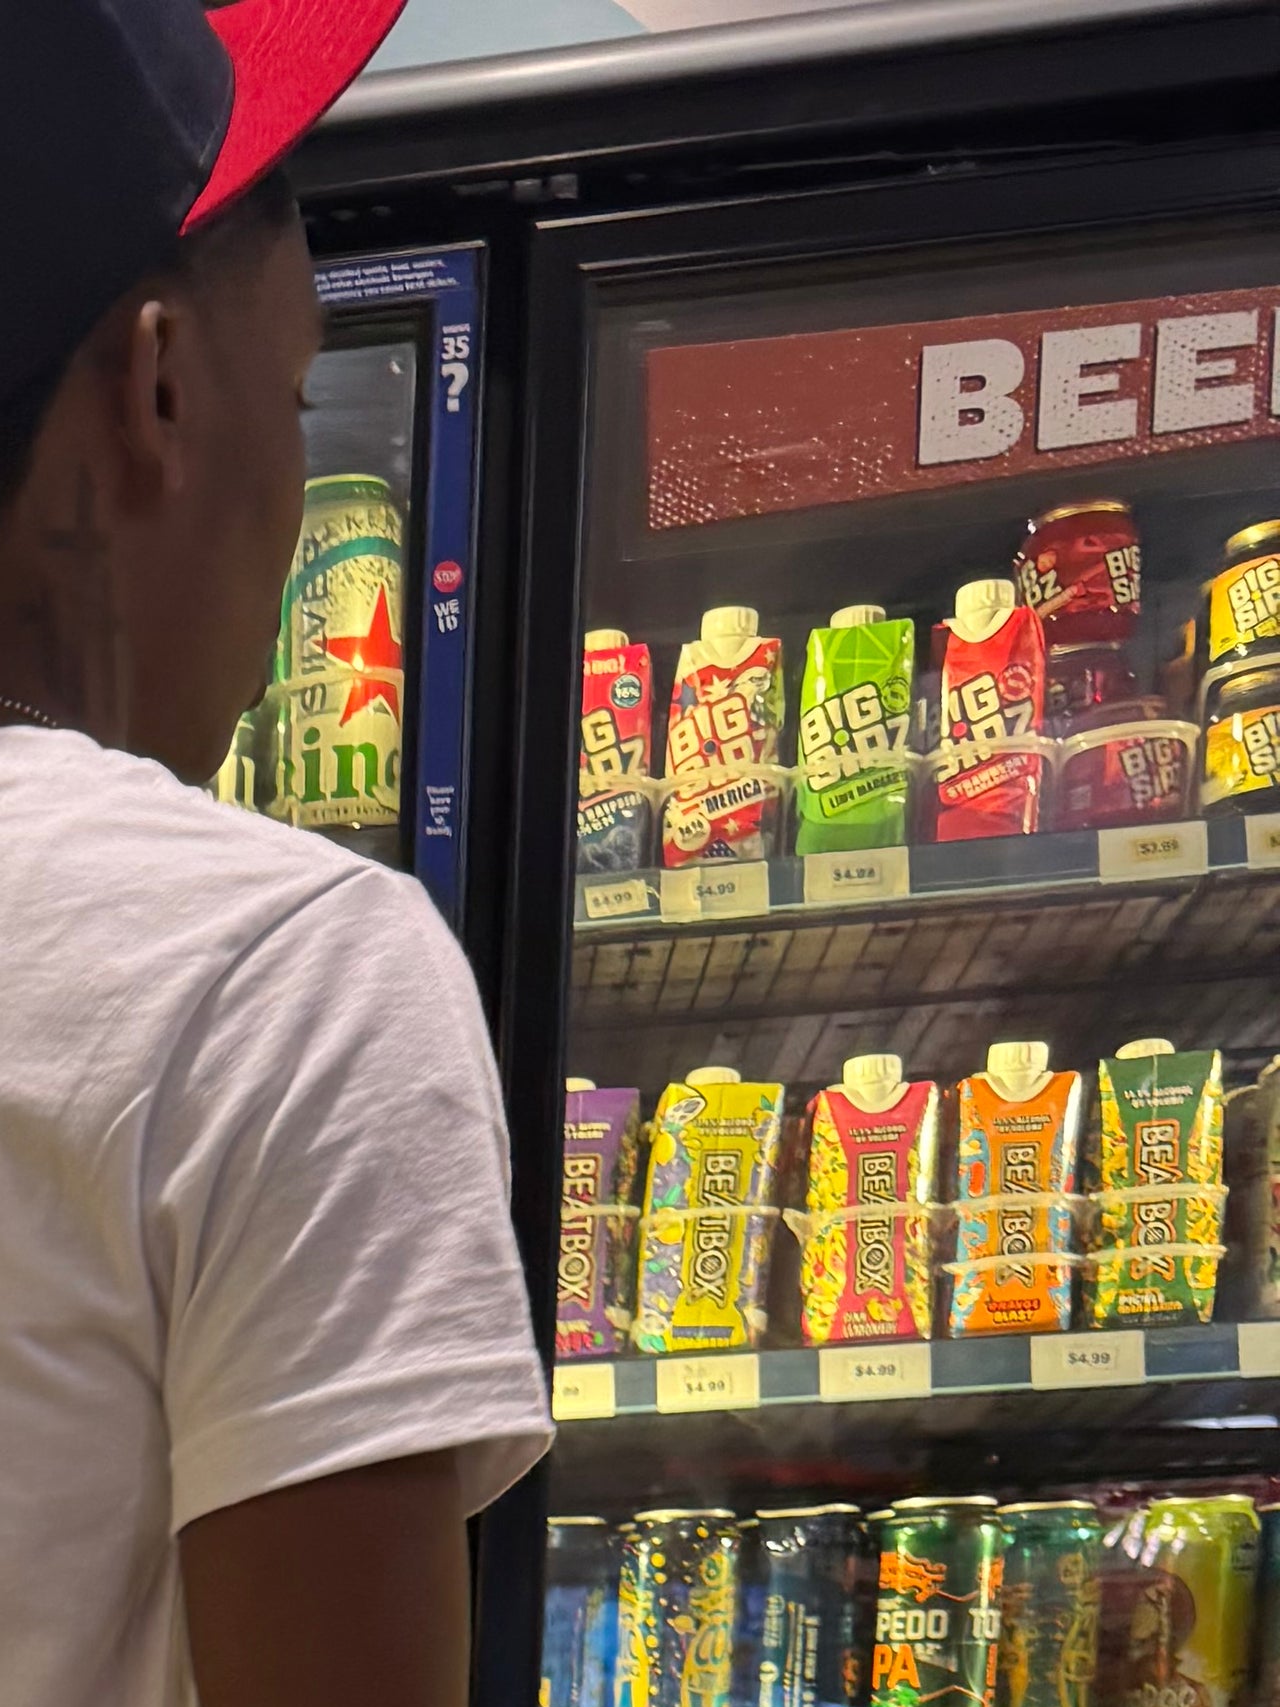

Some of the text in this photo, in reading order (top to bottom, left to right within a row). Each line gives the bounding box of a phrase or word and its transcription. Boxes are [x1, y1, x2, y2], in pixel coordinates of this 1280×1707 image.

[917, 307, 1280, 466] BEE
[434, 599, 459, 617] WE
[695, 882, 736, 898] $4.99
[1068, 1350, 1111, 1365] $4.99
[871, 1643, 921, 1690] PA
